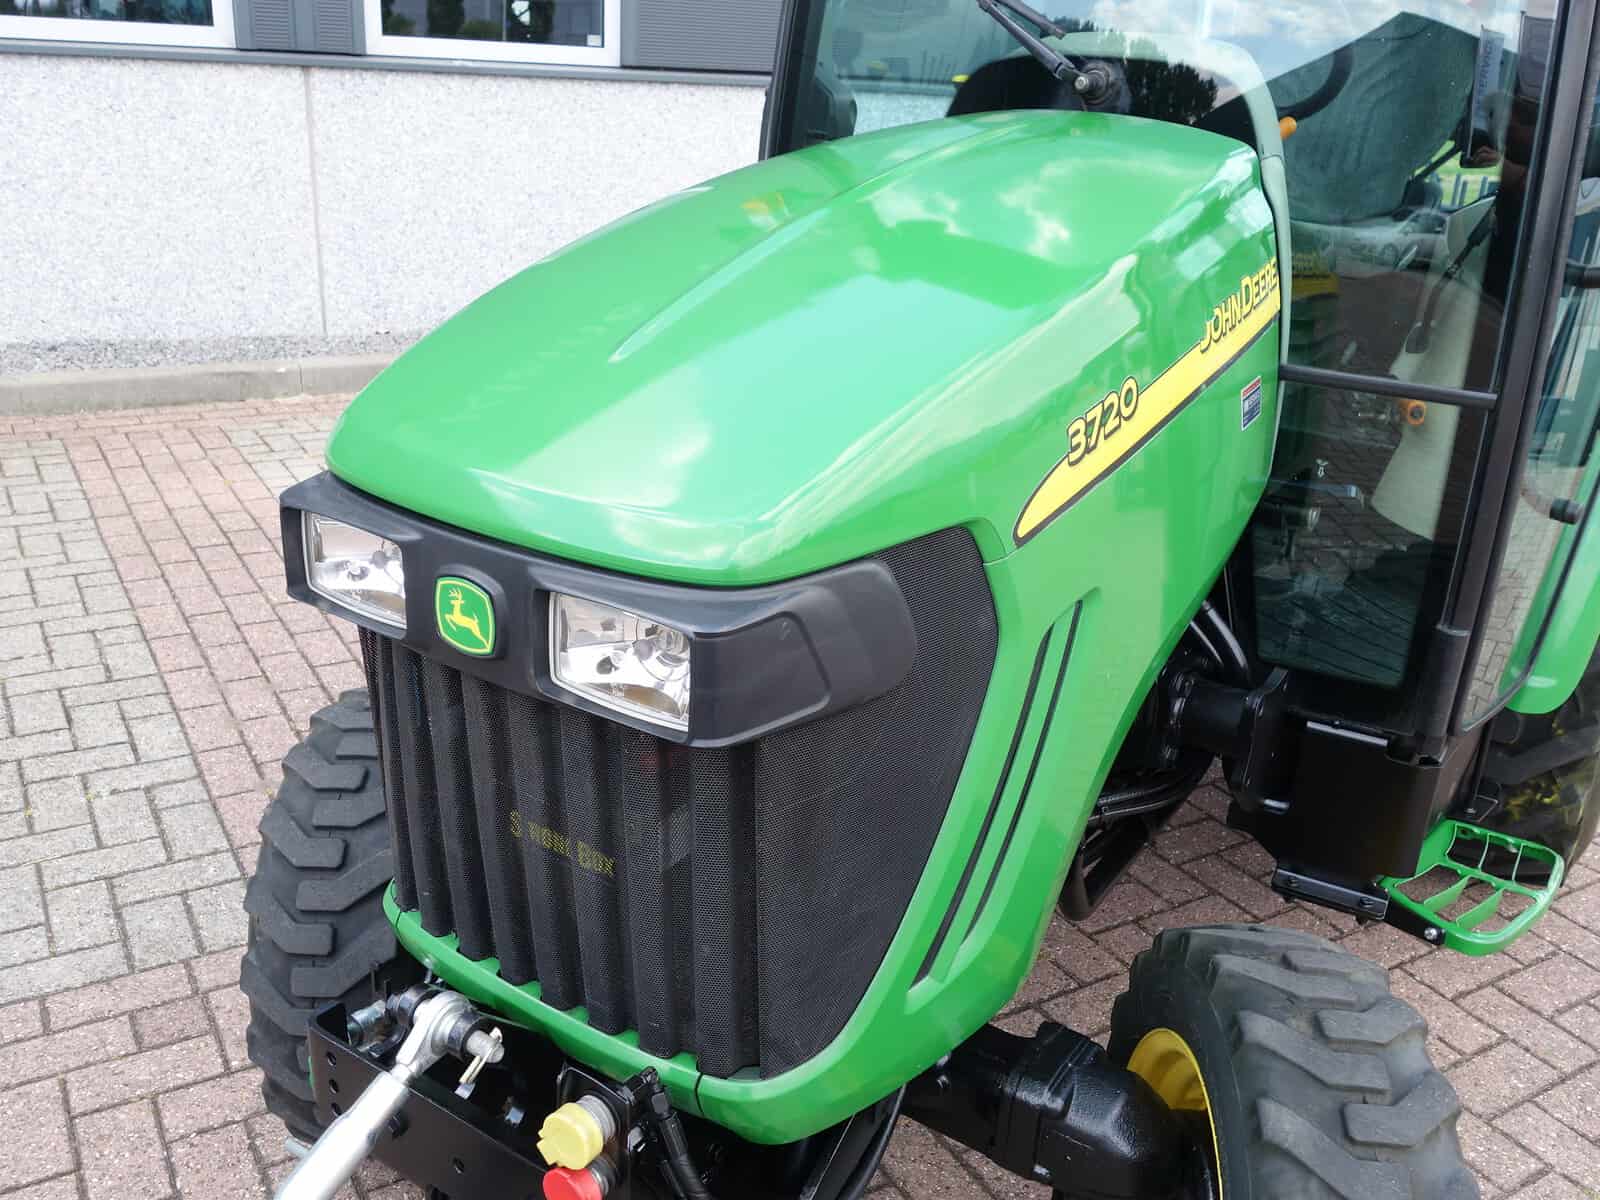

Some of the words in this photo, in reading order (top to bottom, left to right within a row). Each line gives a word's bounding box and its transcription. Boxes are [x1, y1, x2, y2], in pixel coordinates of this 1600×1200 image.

[1200, 291, 1242, 354] JOHN
[1240, 256, 1279, 320] DEERE
[1066, 375, 1139, 466] 3720
